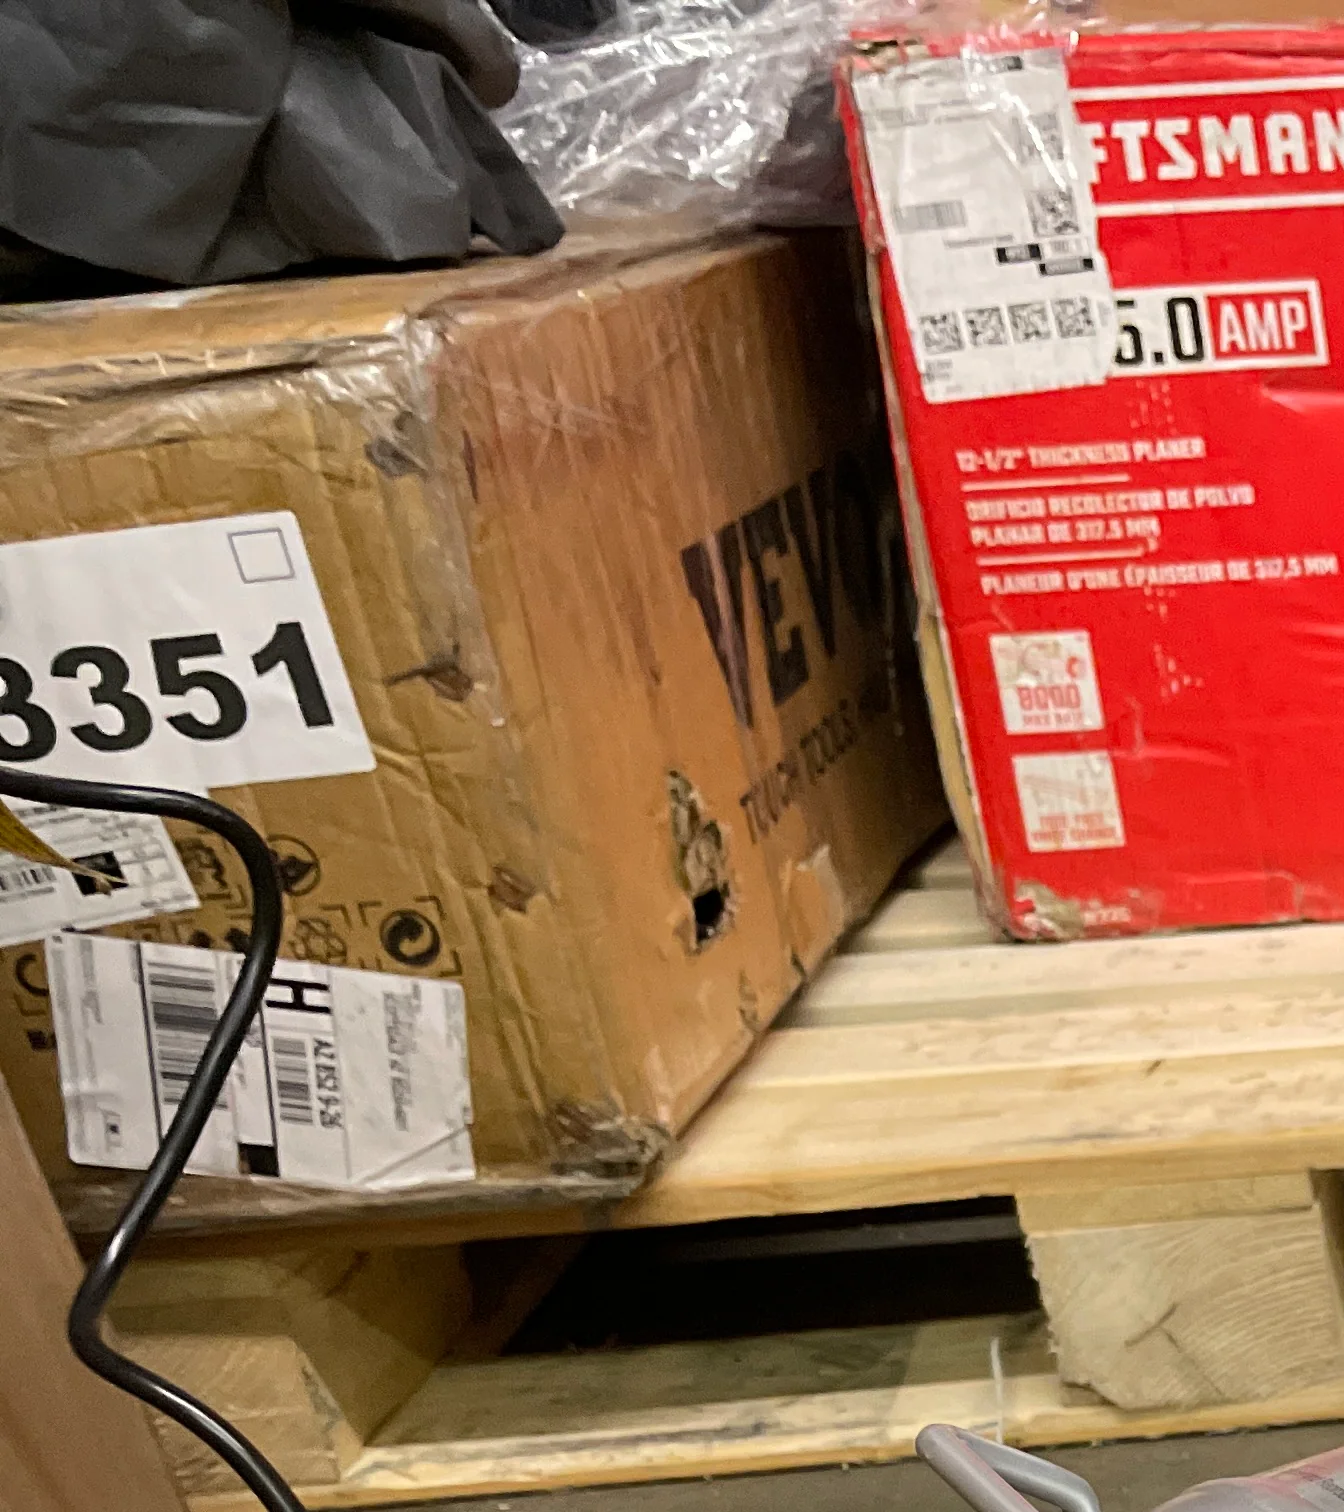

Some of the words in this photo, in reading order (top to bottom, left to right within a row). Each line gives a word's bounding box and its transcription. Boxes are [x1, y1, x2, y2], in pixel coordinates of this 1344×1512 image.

[1219, 299, 1308, 352] AMP
[1027, 441, 1131, 468] THICKNESS
[1132, 436, 1206, 461] PLANER
[1166, 487, 1192, 509] DE
